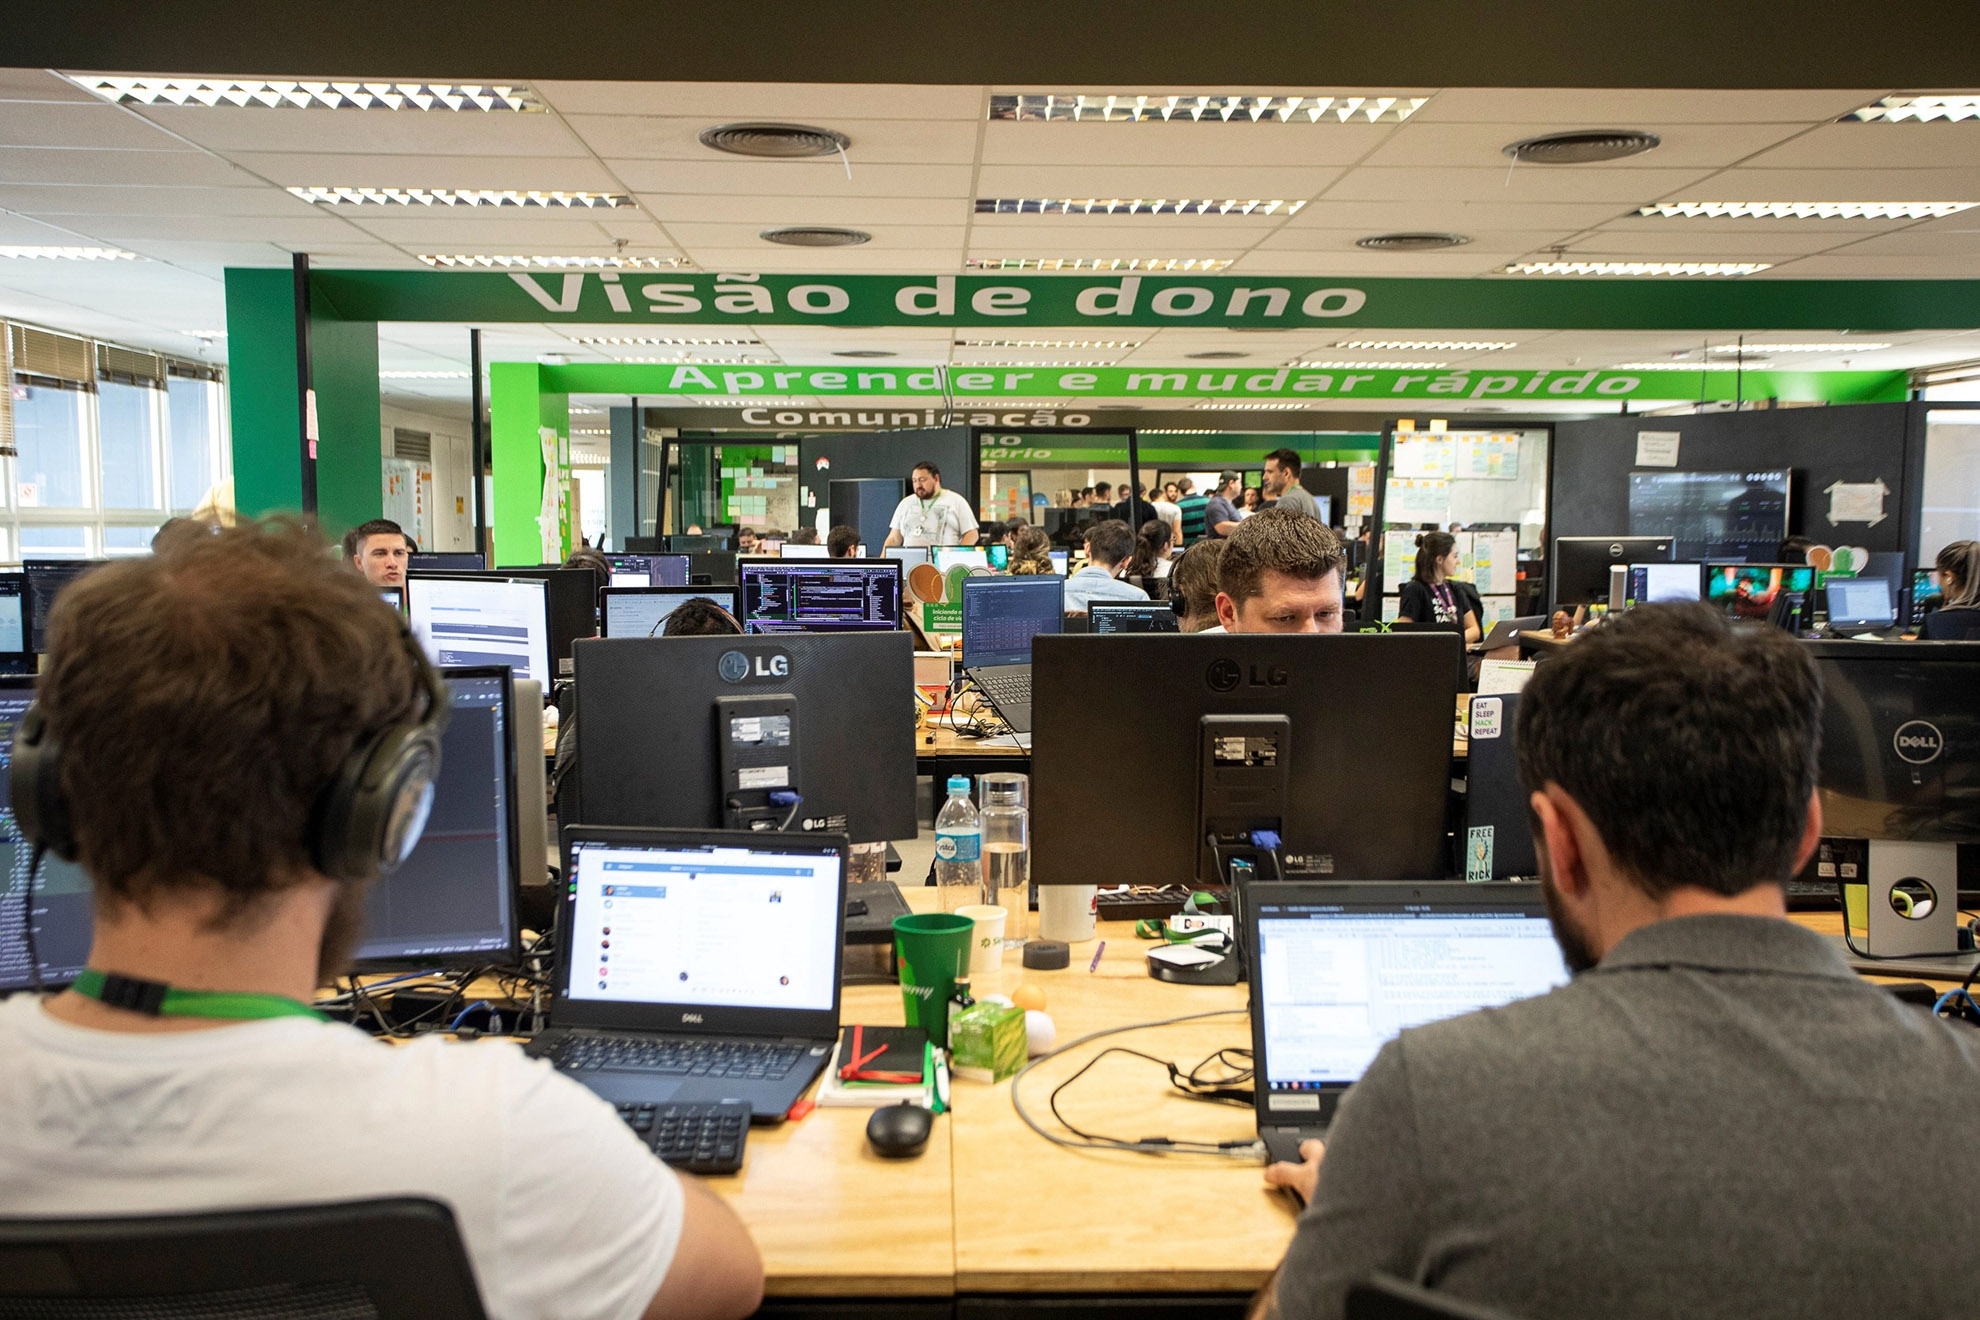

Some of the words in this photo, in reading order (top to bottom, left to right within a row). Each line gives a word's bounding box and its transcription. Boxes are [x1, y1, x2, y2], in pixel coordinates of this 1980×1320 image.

[507, 272, 850, 314] Visão
[894, 275, 1032, 316] de
[1075, 276, 1367, 318] dono
[668, 365, 1034, 394] Aprender
[1058, 372, 1099, 391] e
[1124, 369, 1376, 393] mudar
[1391, 368, 1642, 398] rápido
[755, 655, 789, 676] LG
[1249, 664, 1288, 688] LG
[1899, 736, 1937, 748] DELL
[813, 819, 826, 829] LG
[1470, 828, 1492, 838] FREE
[1468, 870, 1491, 881] RICK
